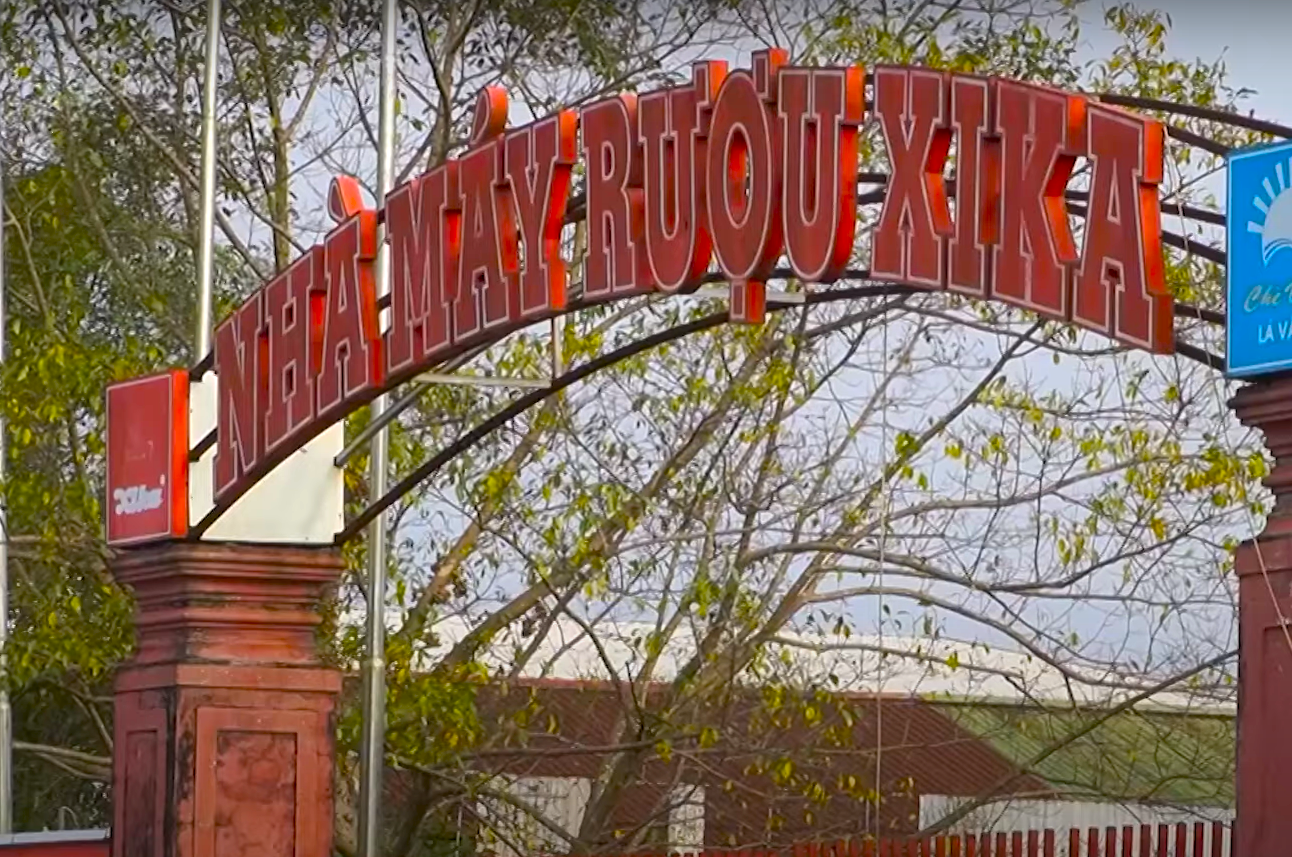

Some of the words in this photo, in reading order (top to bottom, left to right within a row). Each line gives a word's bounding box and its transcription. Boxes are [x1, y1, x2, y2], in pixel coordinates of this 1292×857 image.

[212, 176, 384, 504] NHÀ
[385, 86, 578, 373] MÁY
[580, 48, 864, 325] RƯỢU
[869, 64, 1174, 356] XIKA
